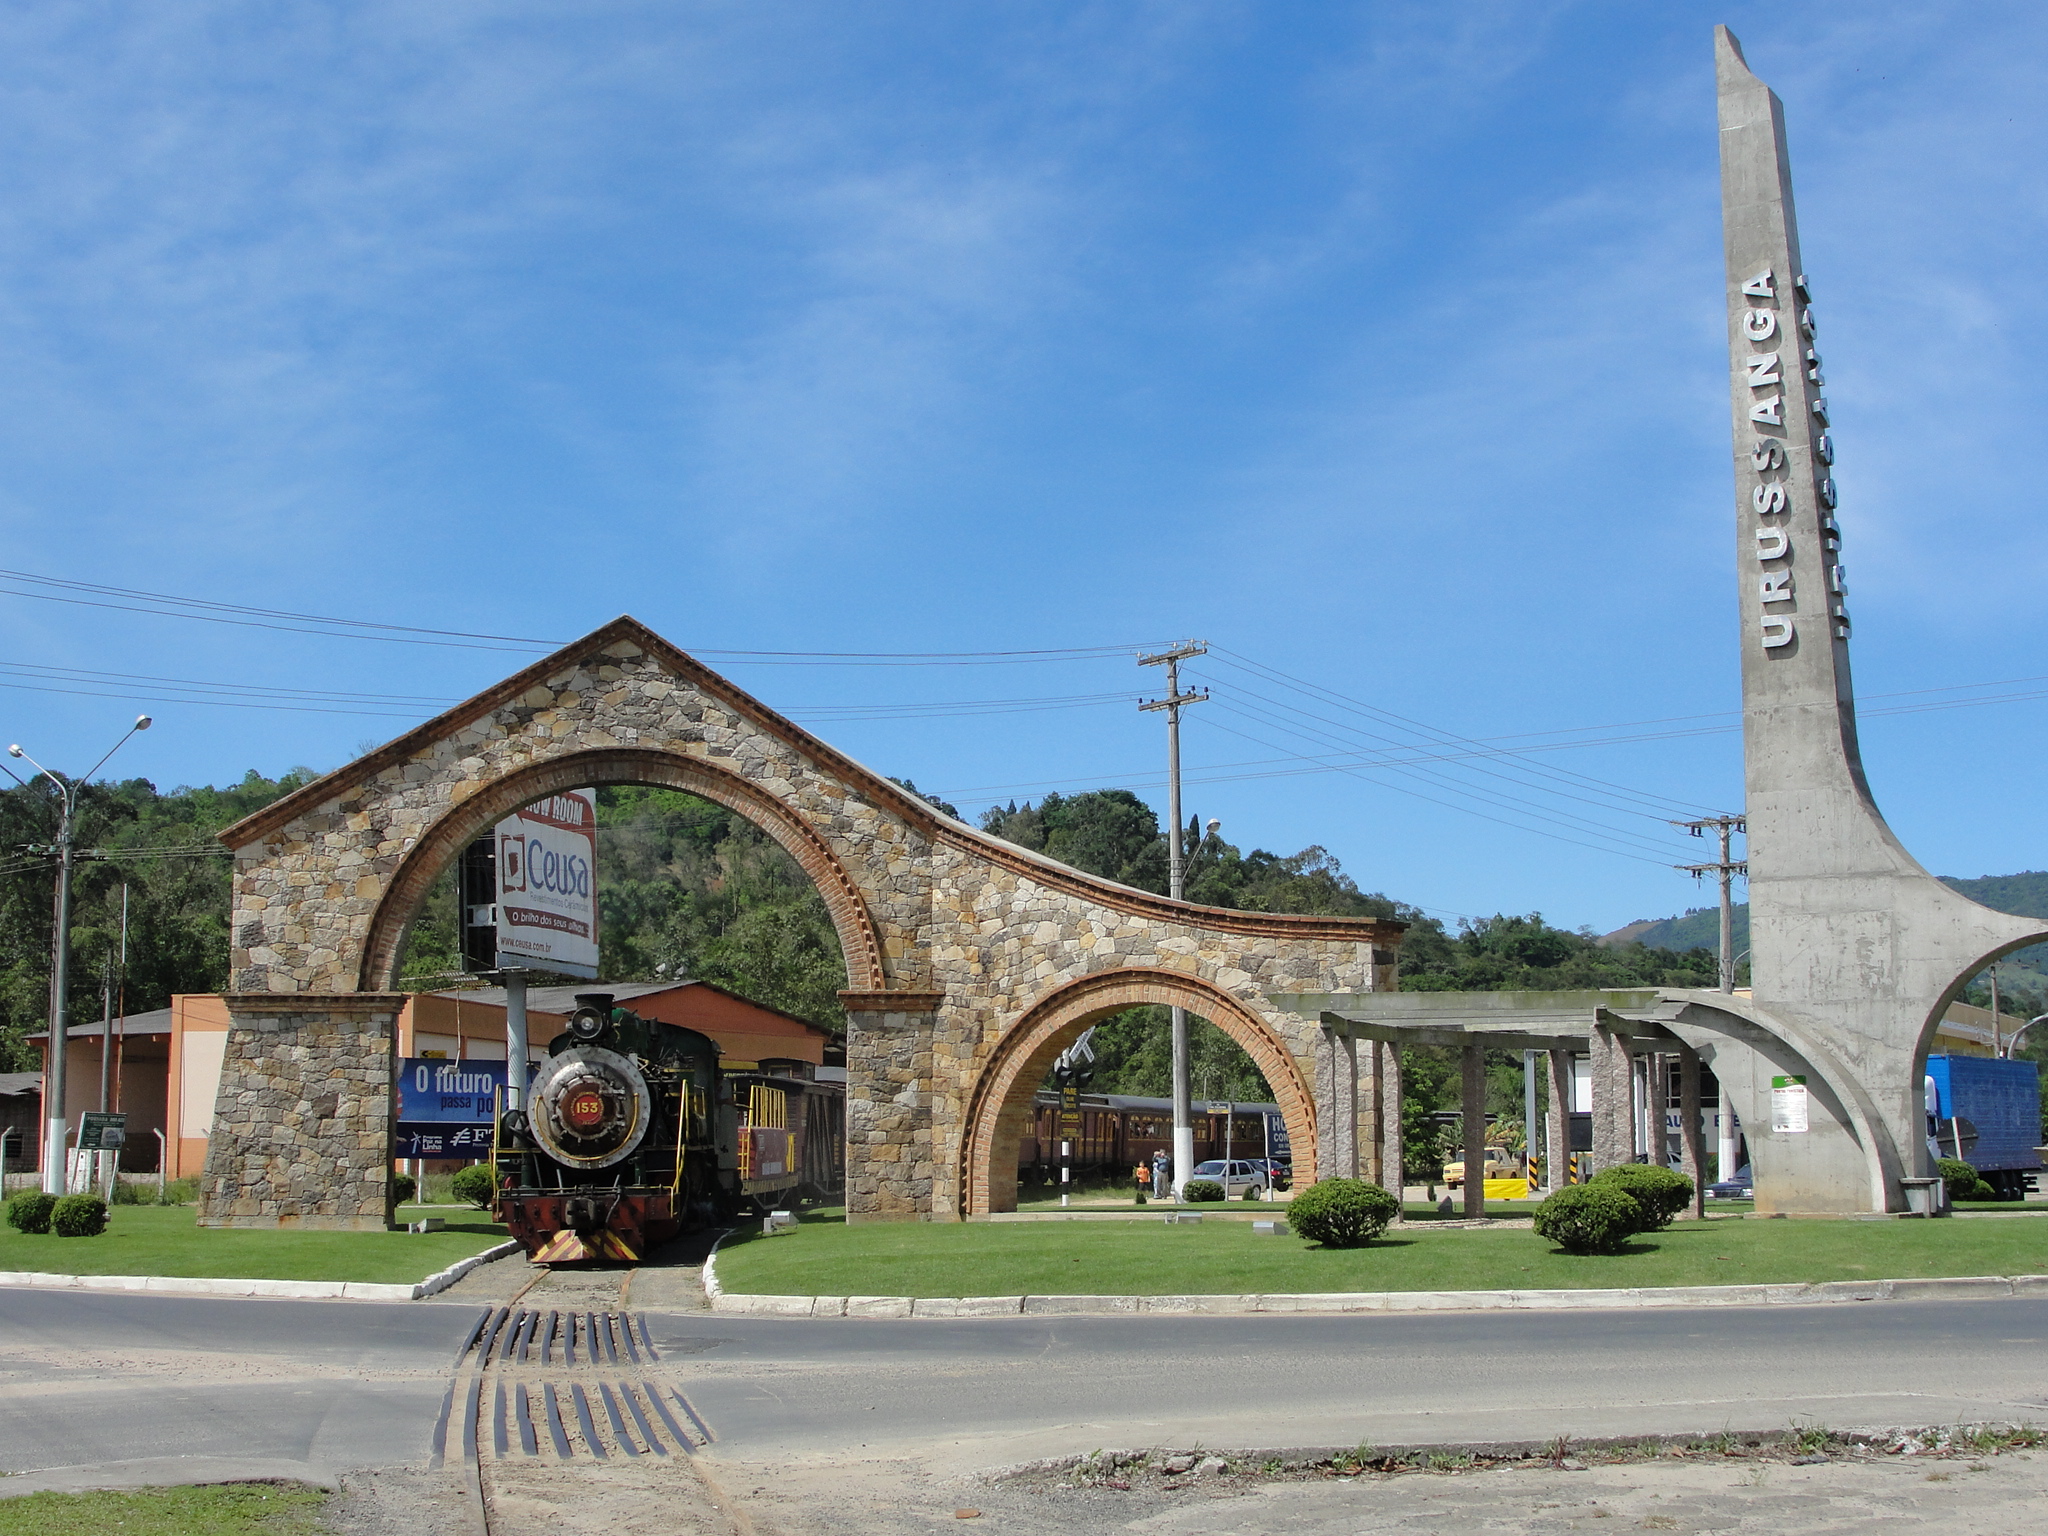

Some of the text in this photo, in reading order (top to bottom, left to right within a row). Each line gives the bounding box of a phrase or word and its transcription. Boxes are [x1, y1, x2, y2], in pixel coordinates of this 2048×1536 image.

[1742, 267, 1793, 649] URUSSANGA
[552, 795, 584, 826] ROOM
[527, 838, 588, 899] Ceusa
[512, 911, 519, 922] O
[520, 912, 539, 924] brilho
[540, 915, 552, 926] dos
[553, 918, 567, 929] seus
[500, 936, 552, 953] www.ceusa.com.br
[415, 1065, 493, 1094] O futuro
[441, 1096, 494, 1117] passa po
[576, 1102, 599, 1114] 153
